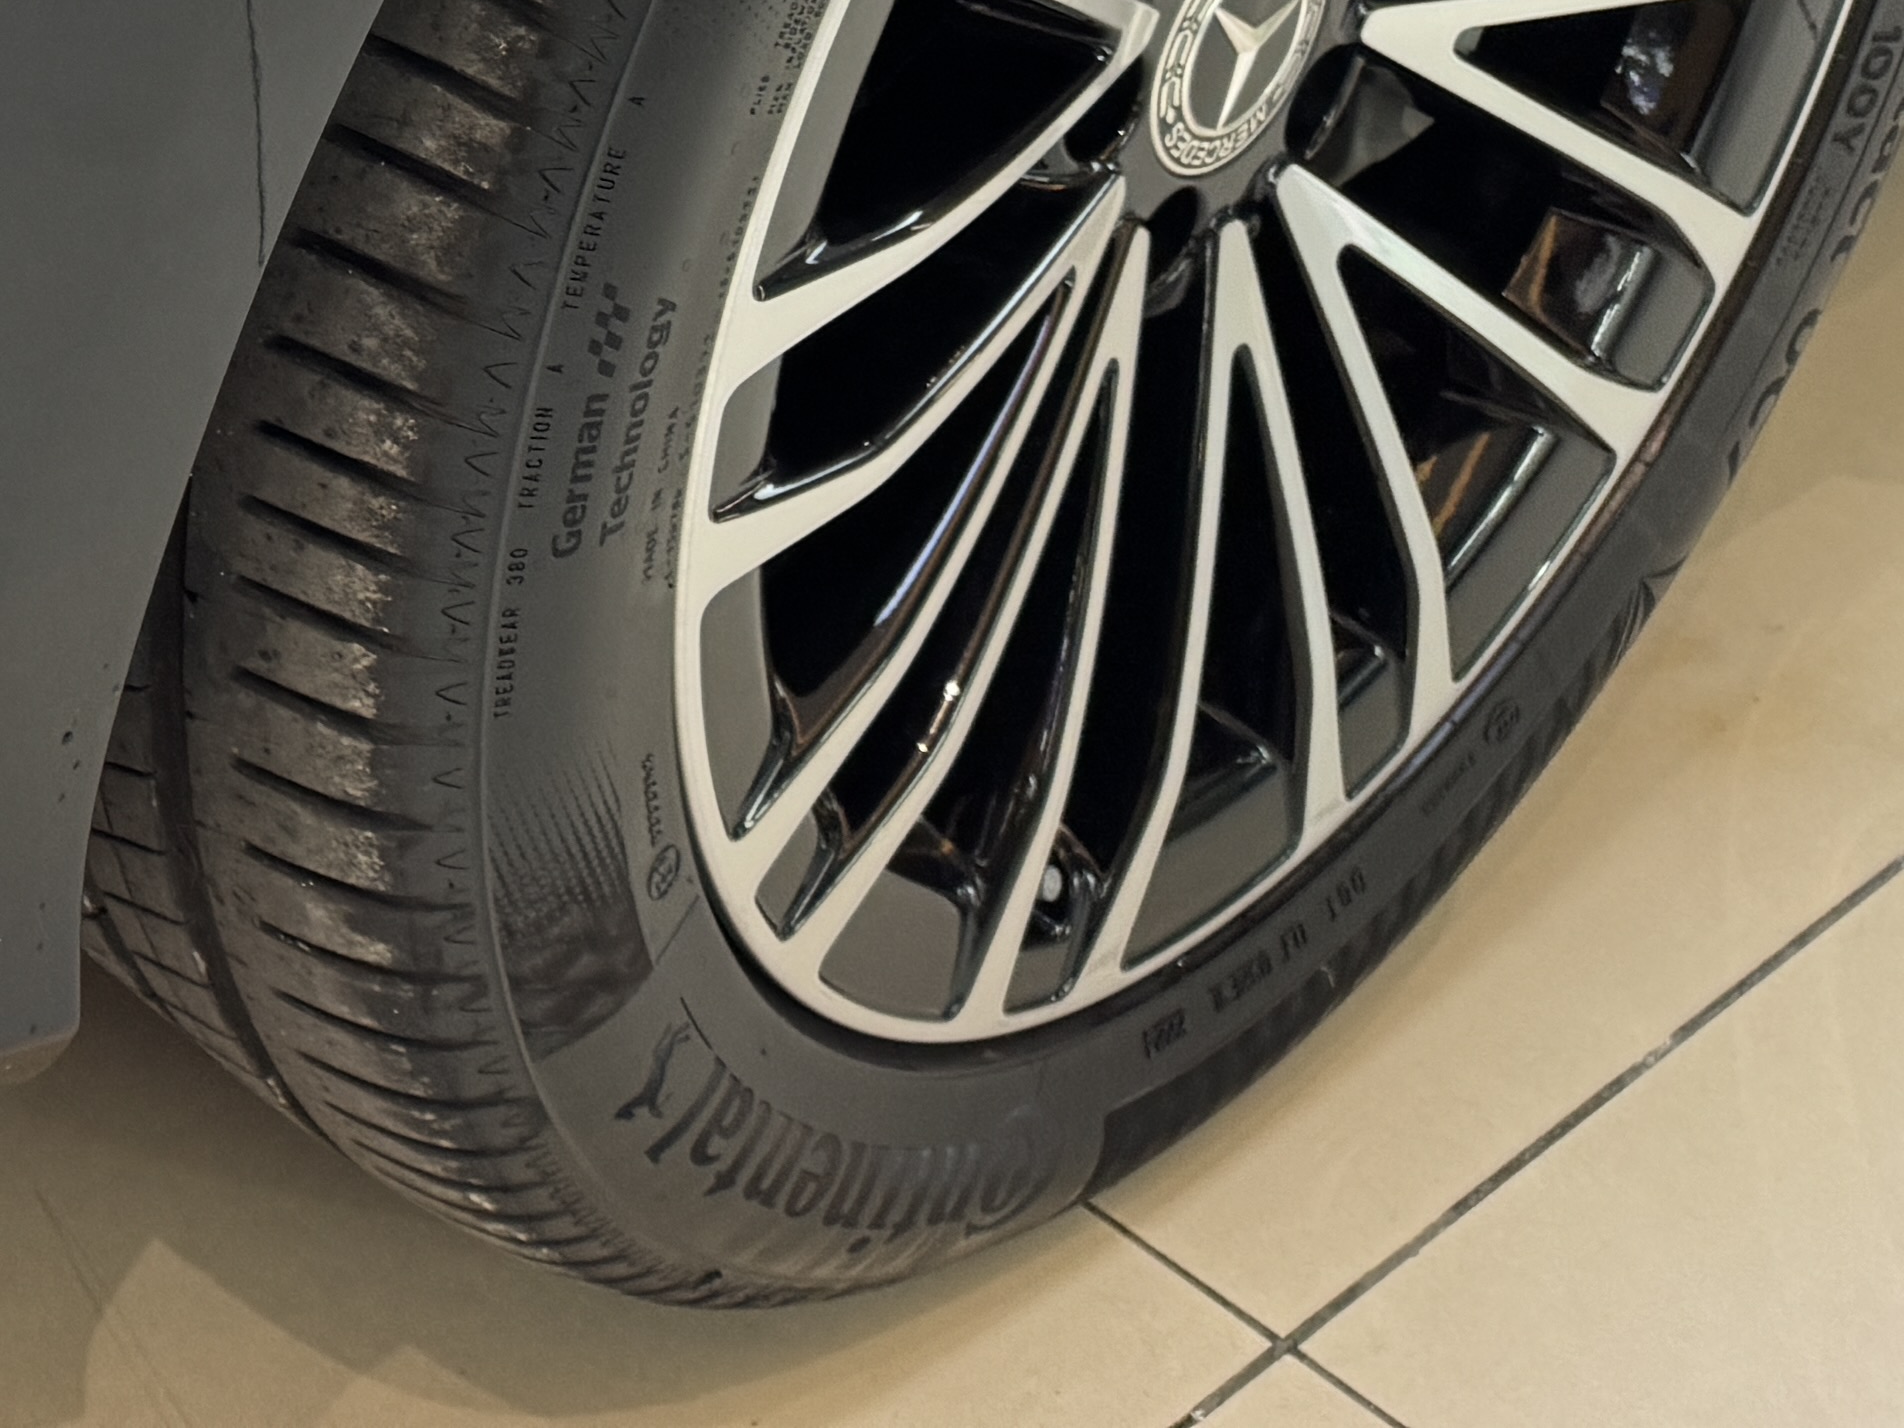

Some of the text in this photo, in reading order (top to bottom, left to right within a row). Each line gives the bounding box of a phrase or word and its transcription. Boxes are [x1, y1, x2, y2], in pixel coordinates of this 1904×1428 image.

[562, 147, 628, 312] TEMPERATURE
[516, 406, 554, 510] TRACTION
[551, 392, 610, 560] German
[598, 296, 678, 547] Technology
[504, 547, 529, 585] 380
[644, 1059, 1058, 1252] Continental
